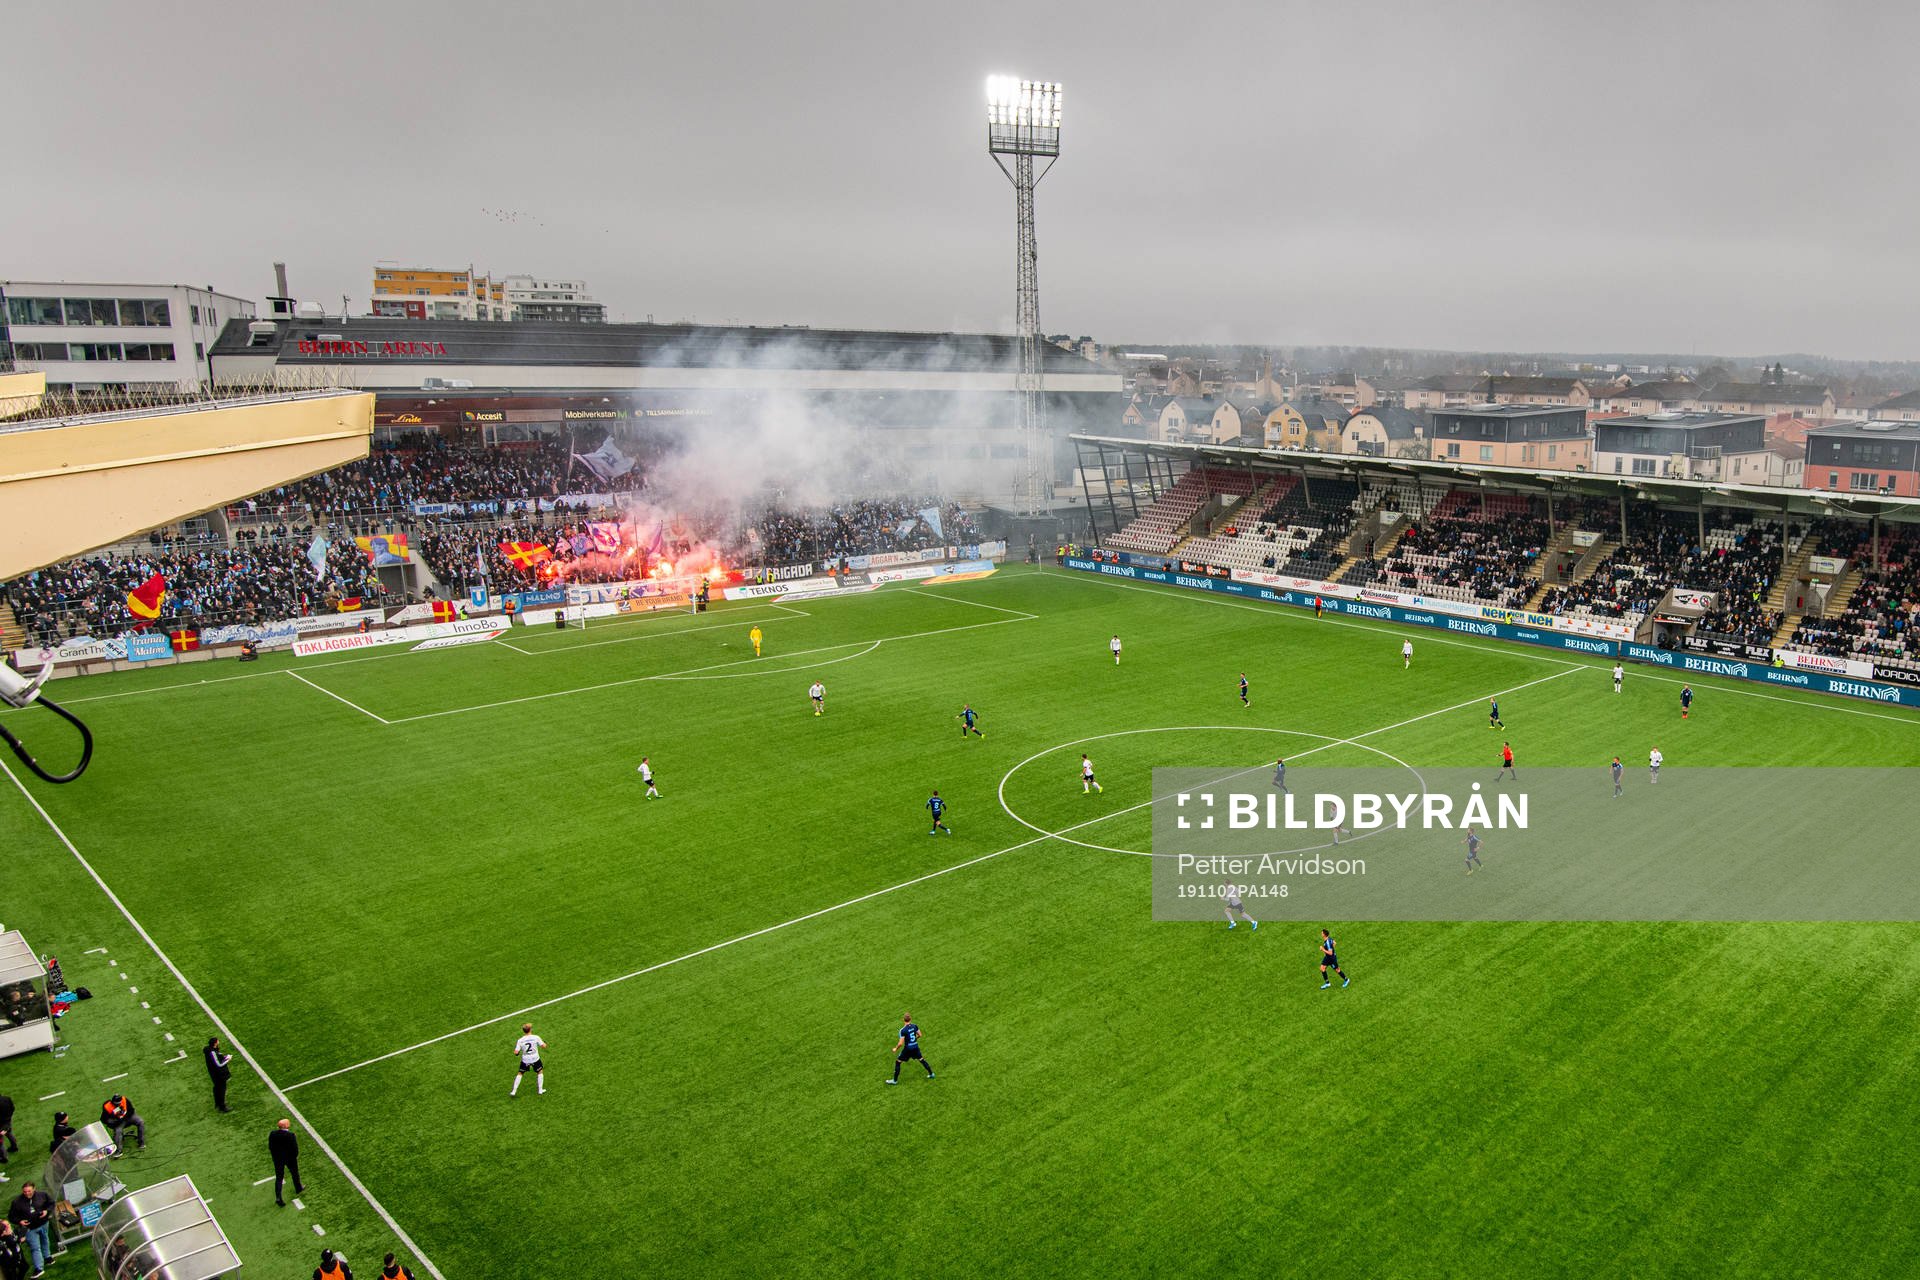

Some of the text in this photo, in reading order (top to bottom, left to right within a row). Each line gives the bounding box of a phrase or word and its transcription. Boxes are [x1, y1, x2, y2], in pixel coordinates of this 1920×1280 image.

[298, 340, 447, 355] BEHRN ARENA
[476, 412, 503, 421] Accesit
[565, 410, 616, 418] Mobilverkstan
[1101, 564, 1127, 576] BEHRN
[1176, 576, 1203, 588] BEHRN
[750, 585, 788, 595] TEKNOS
[1346, 604, 1381, 616] BEHRN
[1405, 613, 1425, 622] BEHRN
[453, 620, 498, 633] InnoBo
[1448, 620, 1484, 635] BEHRN
[296, 635, 374, 654] TAKLÄGGAR'N
[1565, 639, 1598, 651] BEHRN
[1686, 636, 1708, 648] FLEX
[59, 648, 89, 658] Grant
[1745, 645, 1770, 657] FLEX
[1685, 657, 1731, 676] BEHRN
[1798, 654, 1834, 668] BEHRN
[1767, 671, 1798, 683] BEHRN
[1829, 680, 1881, 699] BEHRN
[910, 1031, 916, 1042] 5
[525, 1042, 532, 1053] 2
